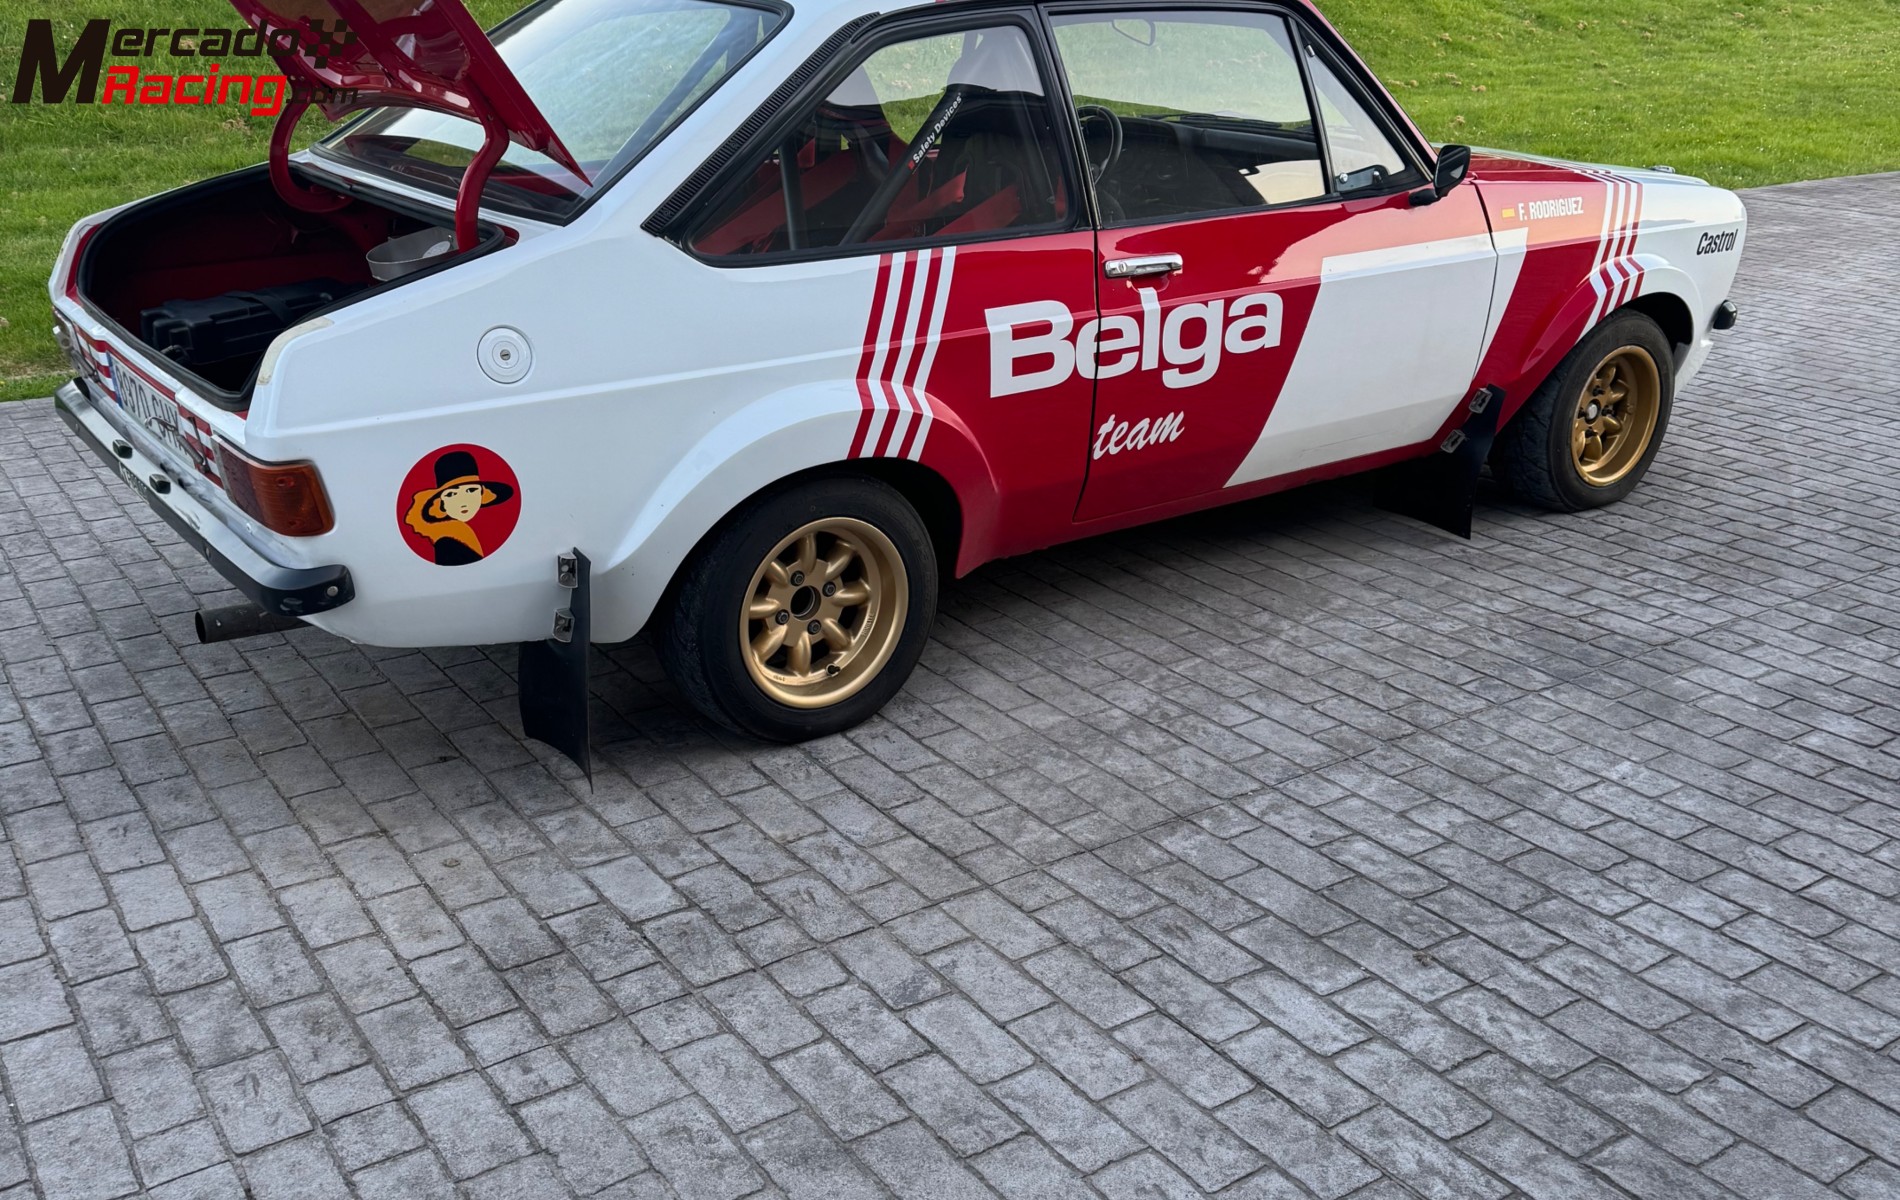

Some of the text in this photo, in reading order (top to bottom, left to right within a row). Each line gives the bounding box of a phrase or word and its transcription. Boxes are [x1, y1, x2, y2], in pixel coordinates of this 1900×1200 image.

[912, 96, 962, 164] Safety Devices
[1518, 196, 1584, 221] F. RODRIGUEZ
[1696, 228, 1738, 256] Castrol
[984, 287, 1284, 398] Belga
[1092, 410, 1185, 460] team
